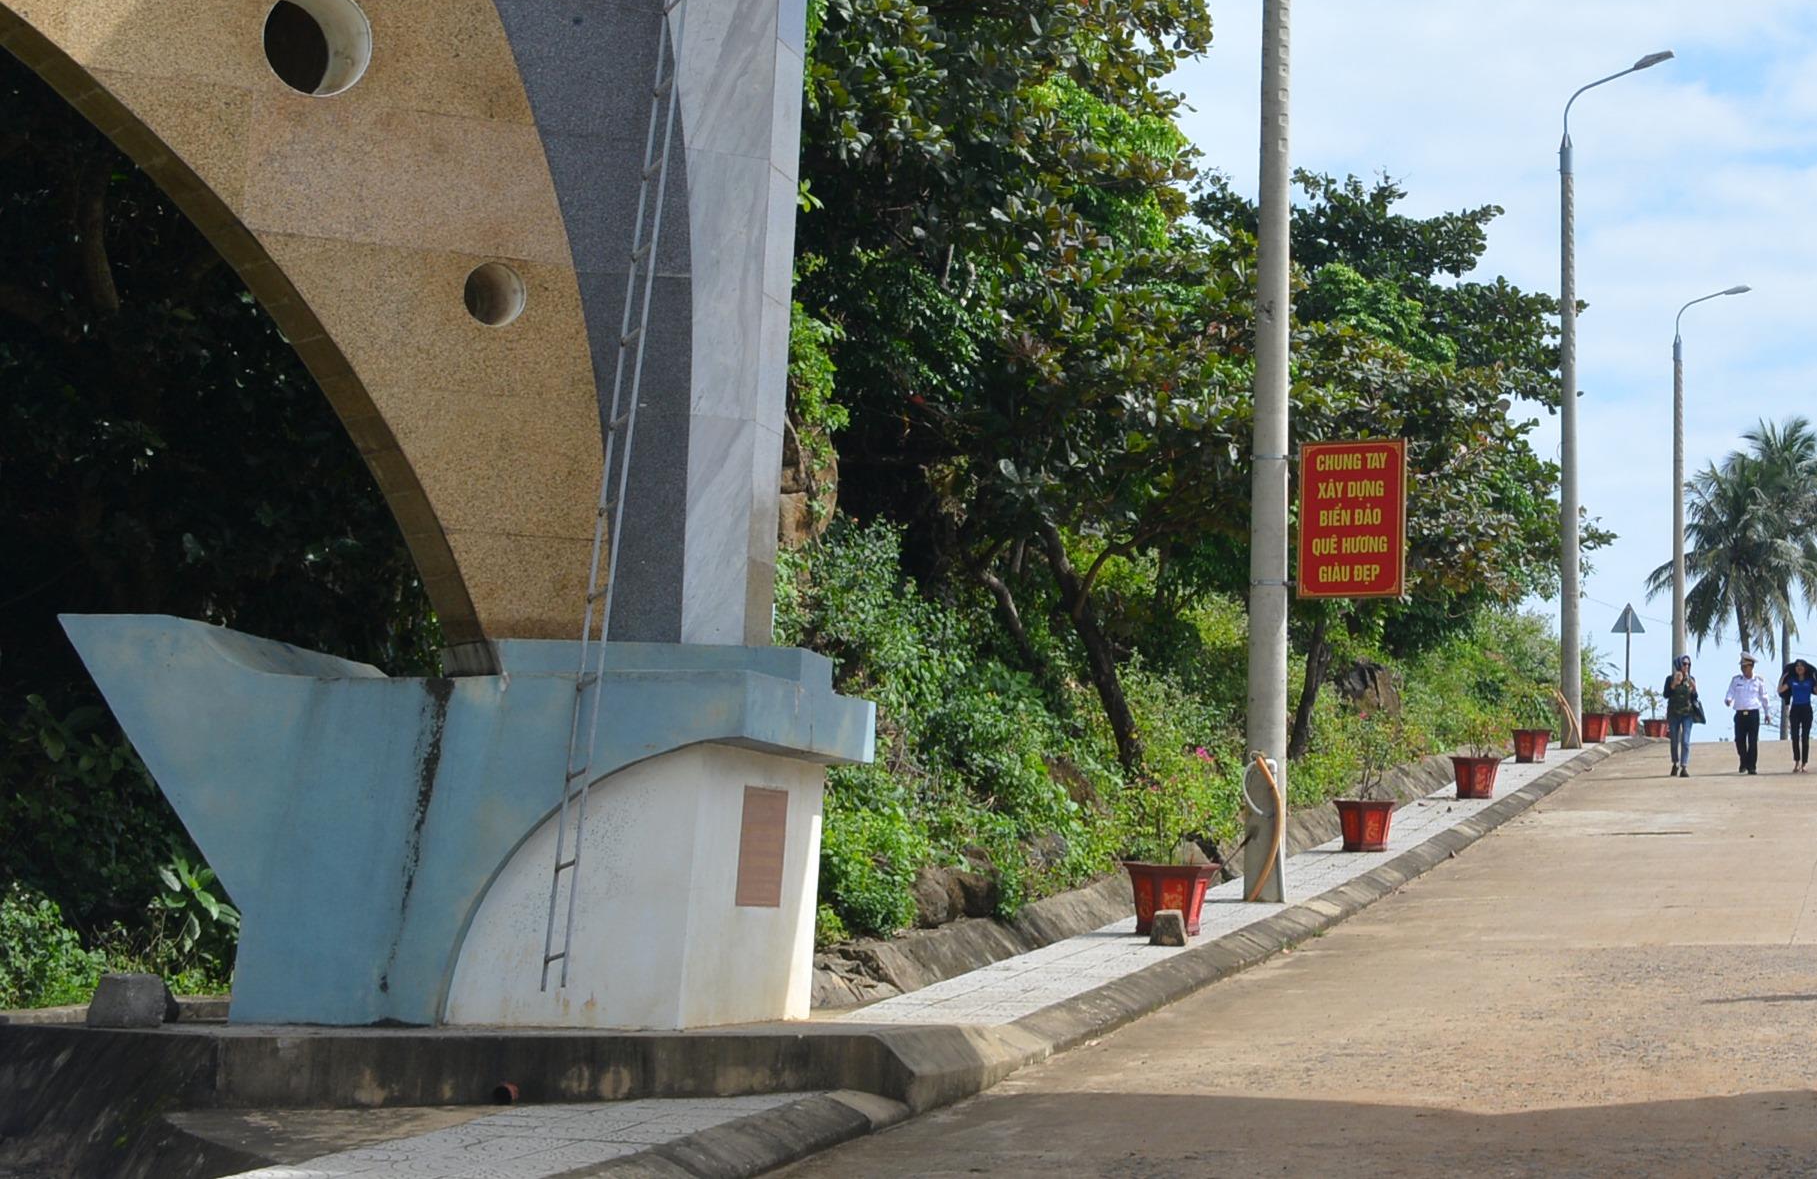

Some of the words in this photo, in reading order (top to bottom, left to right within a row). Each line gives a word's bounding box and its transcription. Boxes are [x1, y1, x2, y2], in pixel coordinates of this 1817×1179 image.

[1316, 453, 1362, 471] CHUNG
[1365, 452, 1387, 469] TAY
[1317, 478, 1343, 499] XÂY
[1347, 479, 1384, 501] DỰNG
[1319, 503, 1350, 526] BIỂN
[1354, 503, 1381, 526] ĐẢO
[1312, 534, 1338, 557] QUÊ
[1342, 535, 1388, 554] HƯƠNG
[1318, 562, 1350, 582] GIÀU
[1354, 564, 1380, 585] ĐẸP
